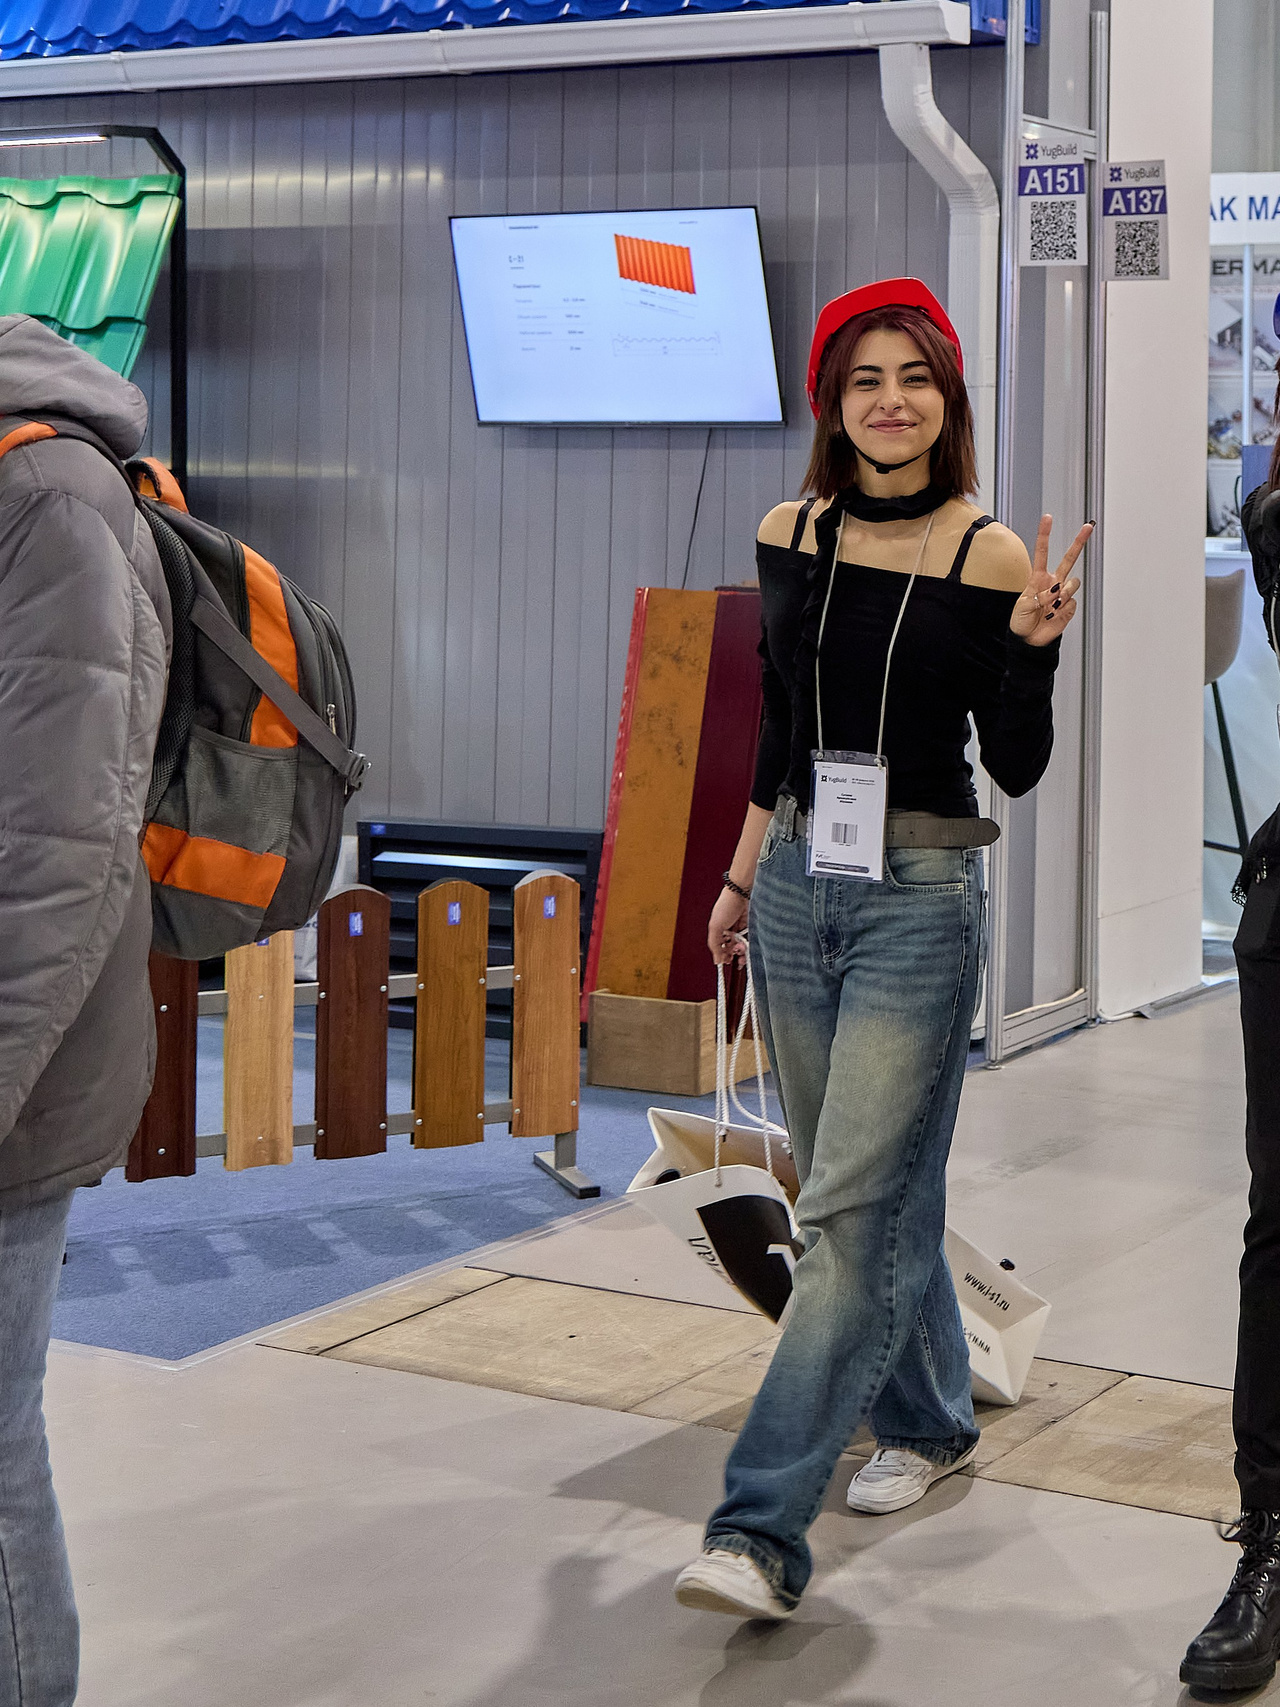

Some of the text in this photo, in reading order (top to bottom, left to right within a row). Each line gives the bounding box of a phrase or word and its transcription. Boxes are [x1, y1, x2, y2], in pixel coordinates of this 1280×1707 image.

[1040, 144, 1077, 160] YugBuild
[1023, 167, 1080, 195] A151
[1123, 166, 1160, 182] YugBuild
[1108, 188, 1164, 214] A137
[963, 1271, 1011, 1312] www.i-s1.ru
